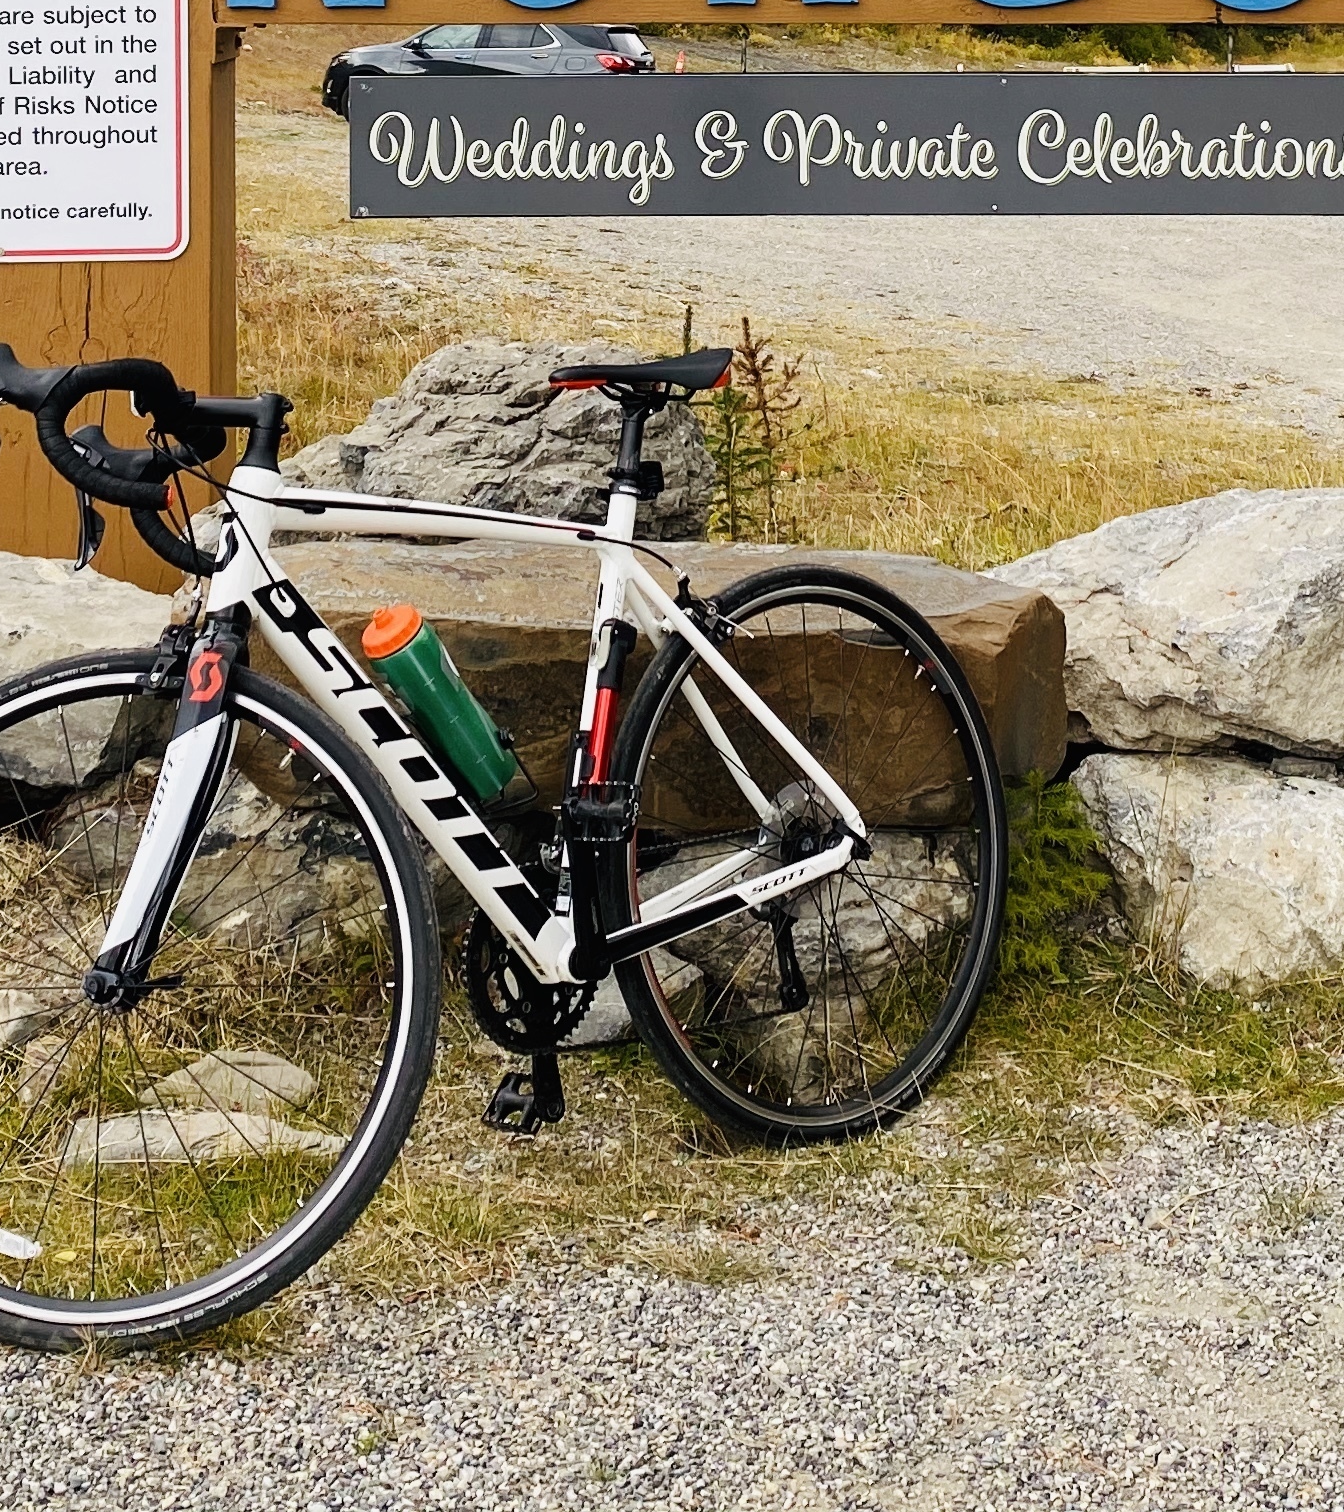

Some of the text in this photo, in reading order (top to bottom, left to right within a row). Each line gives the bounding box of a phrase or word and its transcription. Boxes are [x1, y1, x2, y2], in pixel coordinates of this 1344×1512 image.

[0, 11, 34, 25] are
[44, 5, 126, 28] subject
[135, 6, 156, 23] to
[8, 37, 42, 54] set
[51, 37, 86, 54] out
[95, 35, 112, 53] in
[121, 35, 157, 53] the
[10, 66, 95, 88] Liability
[115, 65, 156, 83] and
[15, 96, 75, 114] Risks
[86, 95, 157, 113] Notice
[32, 126, 157, 148] throughout
[368, 110, 674, 206] Weddings
[695, 111, 749, 179] &
[764, 110, 998, 185] Private
[1, 205, 59, 219] notice
[67, 203, 152, 220] carefully.
[276, 618, 554, 943] SCOTT
[145, 758, 173, 838] SCOTT
[752, 867, 808, 895] SCOTT
